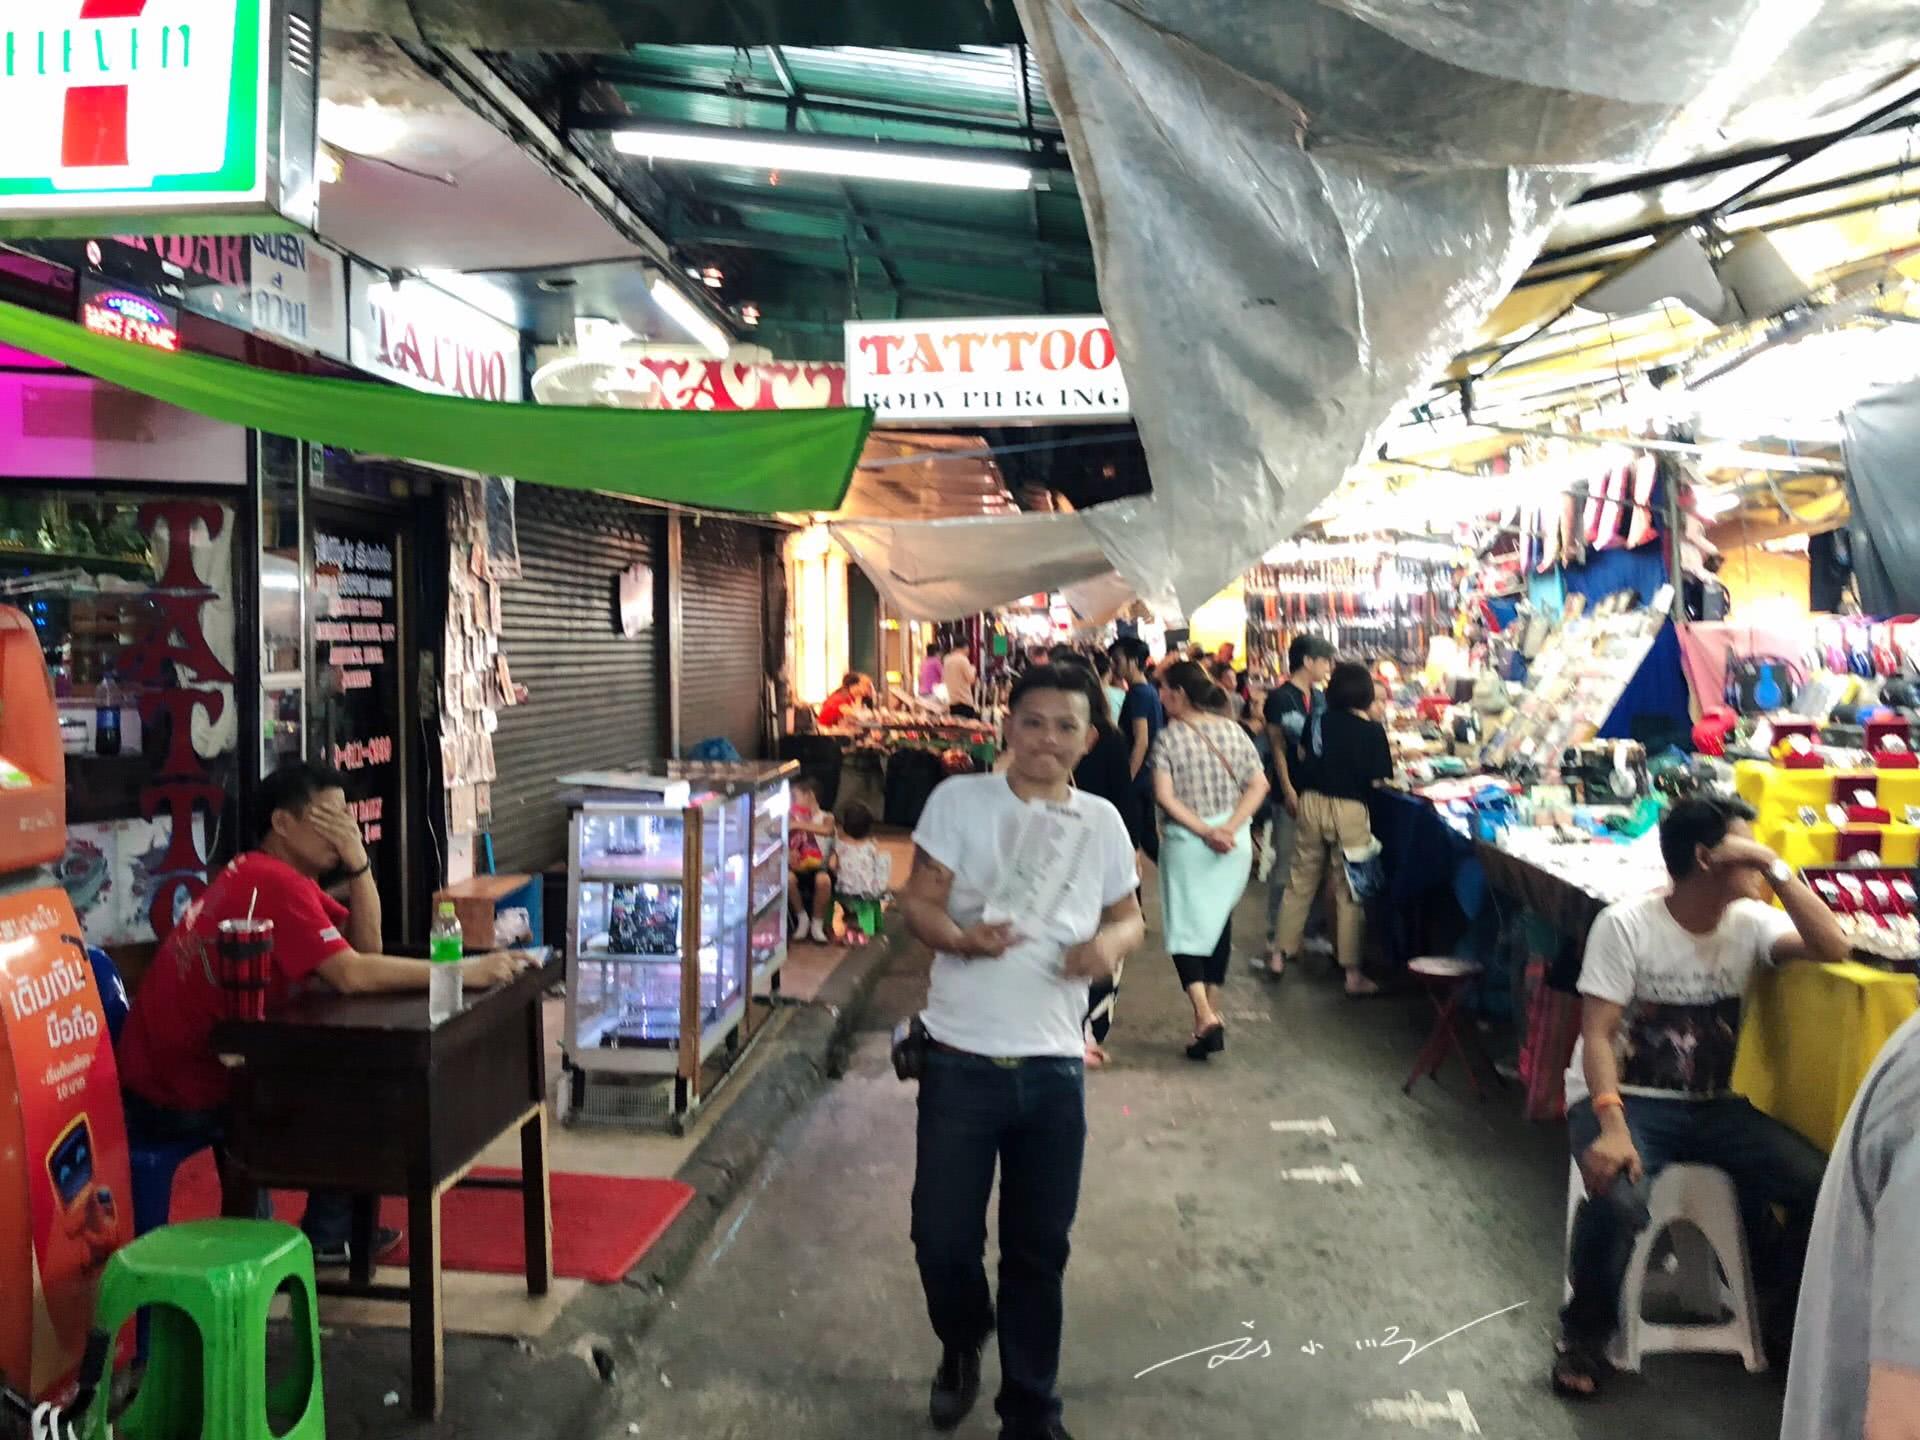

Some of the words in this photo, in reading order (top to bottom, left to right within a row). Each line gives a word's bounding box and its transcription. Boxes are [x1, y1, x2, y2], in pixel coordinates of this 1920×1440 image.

[859, 327, 1117, 376] TATTOO
[863, 389, 945, 409] BODY
[963, 387, 1120, 409] PIERCING
[9, 951, 87, 1021] เติมเงิน
[46, 1004, 98, 1049] มือถือ
